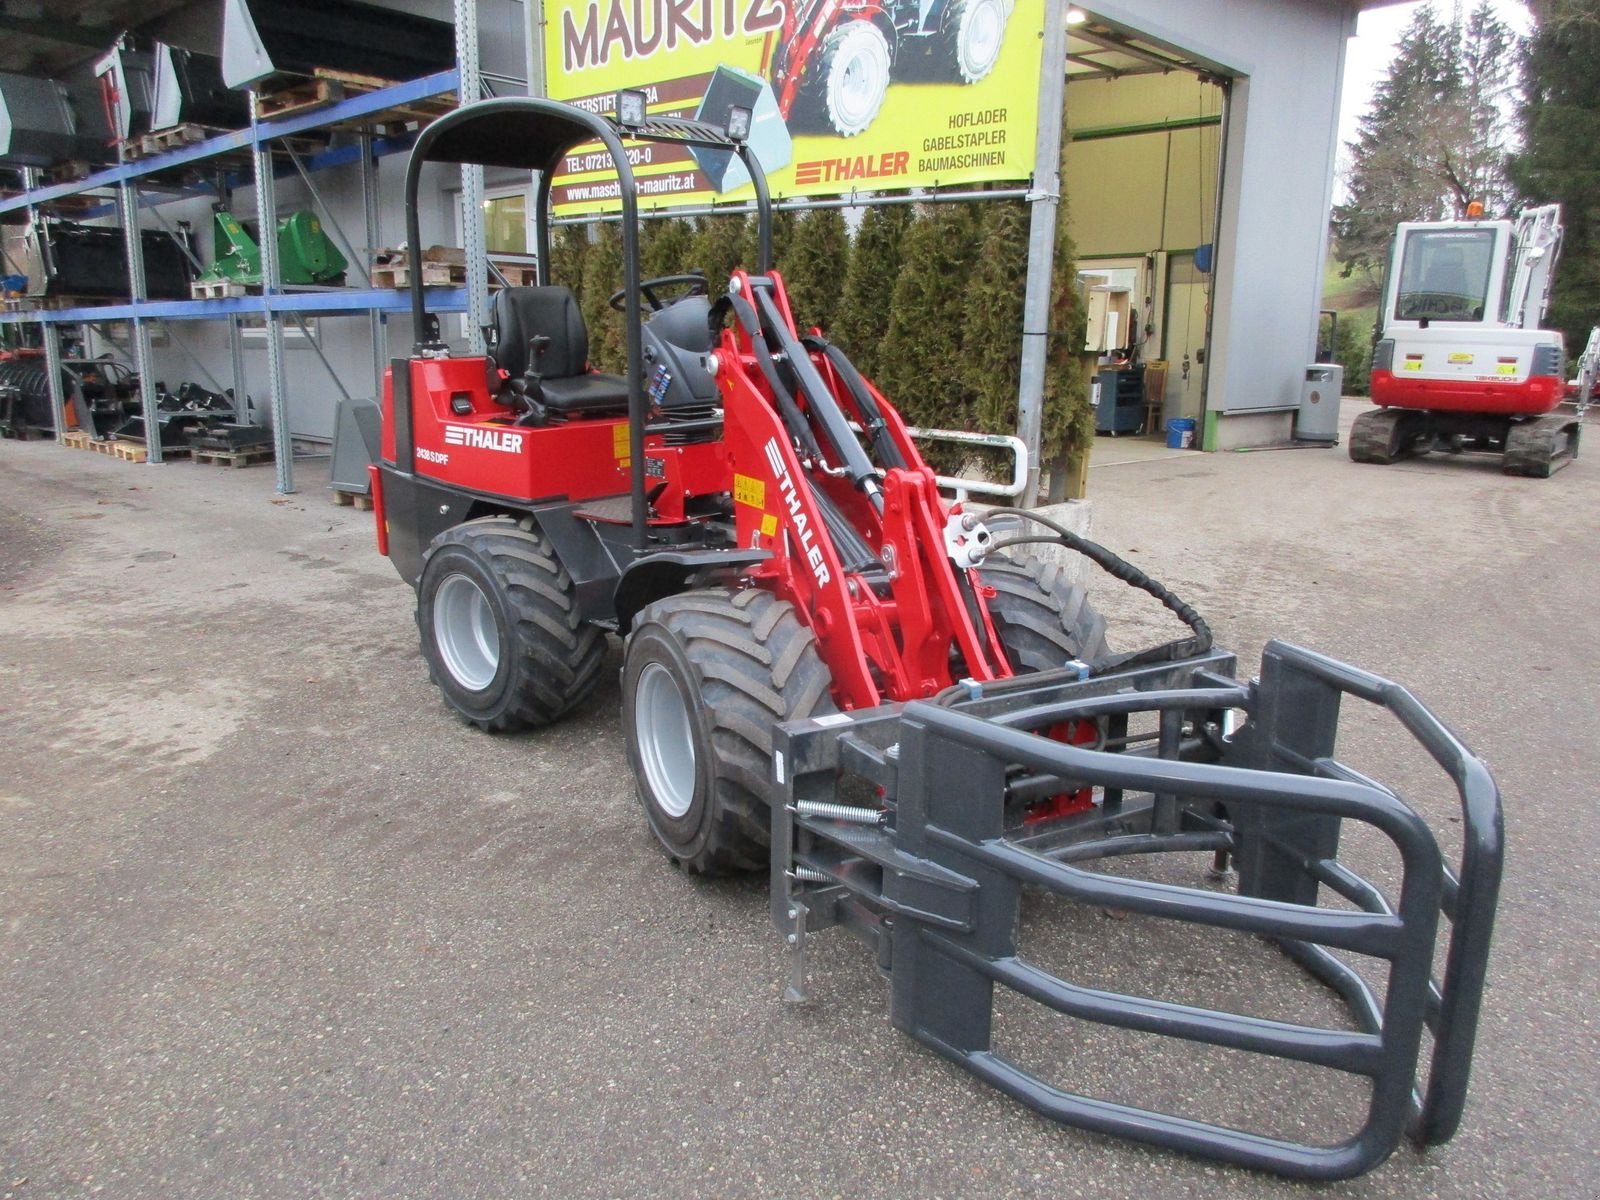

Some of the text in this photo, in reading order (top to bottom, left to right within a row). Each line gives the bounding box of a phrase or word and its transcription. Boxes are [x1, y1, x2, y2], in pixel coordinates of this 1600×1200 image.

[568, 93, 617, 113] TERSTIFT
[949, 108, 1007, 129] HOFLADER
[923, 129, 1006, 152] GABELSTAPLER
[566, 156, 584, 173] TEL:
[822, 151, 910, 182] THALER
[918, 151, 1005, 173] BAUMASCHINEN
[567, 173, 695, 201] www.maschn-mauritz.at
[462, 428, 523, 454] THALER
[779, 470, 831, 589] THALER
